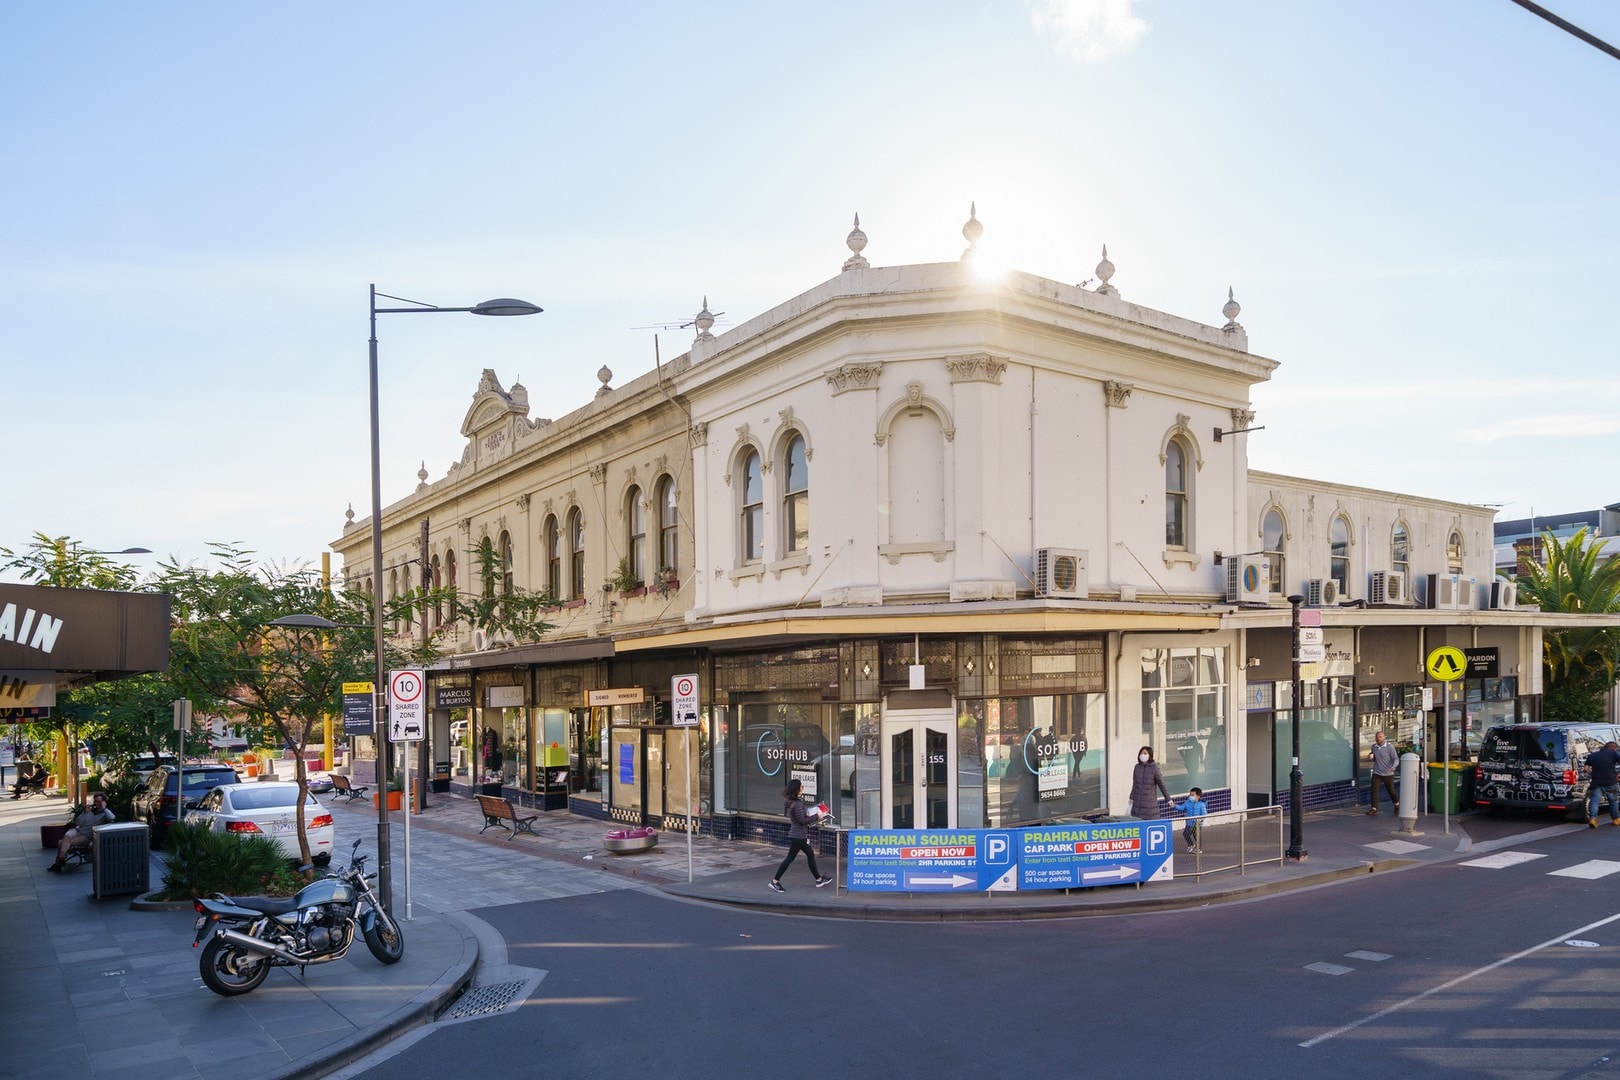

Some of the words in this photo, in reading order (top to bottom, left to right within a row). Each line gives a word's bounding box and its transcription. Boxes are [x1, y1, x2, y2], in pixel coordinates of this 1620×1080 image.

[400, 680, 414, 693] 10
[681, 683, 689, 692] 10
[440, 690, 470, 698] MARCUS
[1496, 738, 1510, 746] five
[767, 749, 808, 761] SOFIHUB
[929, 755, 945, 763] 155
[1051, 768, 1067, 776] LEASE
[802, 774, 815, 782] LEASE
[854, 834, 916, 846] PRAHRAN
[920, 834, 977, 845] SQUARE
[1024, 830, 1088, 843] PRAHRAN
[1091, 827, 1140, 840] SQUARE
[1150, 830, 1164, 851] P
[989, 839, 1006, 859] P
[1024, 845, 1046, 853] CAR
[1047, 843, 1073, 852] PARK
[1083, 841, 1110, 852] OPEN
[1112, 840, 1133, 850] NOW
[854, 847, 872, 856] CAR
[875, 847, 899, 855] PARK
[910, 848, 938, 858] OPEN
[941, 847, 966, 857] NOW
[1049, 876, 1072, 884] parking
